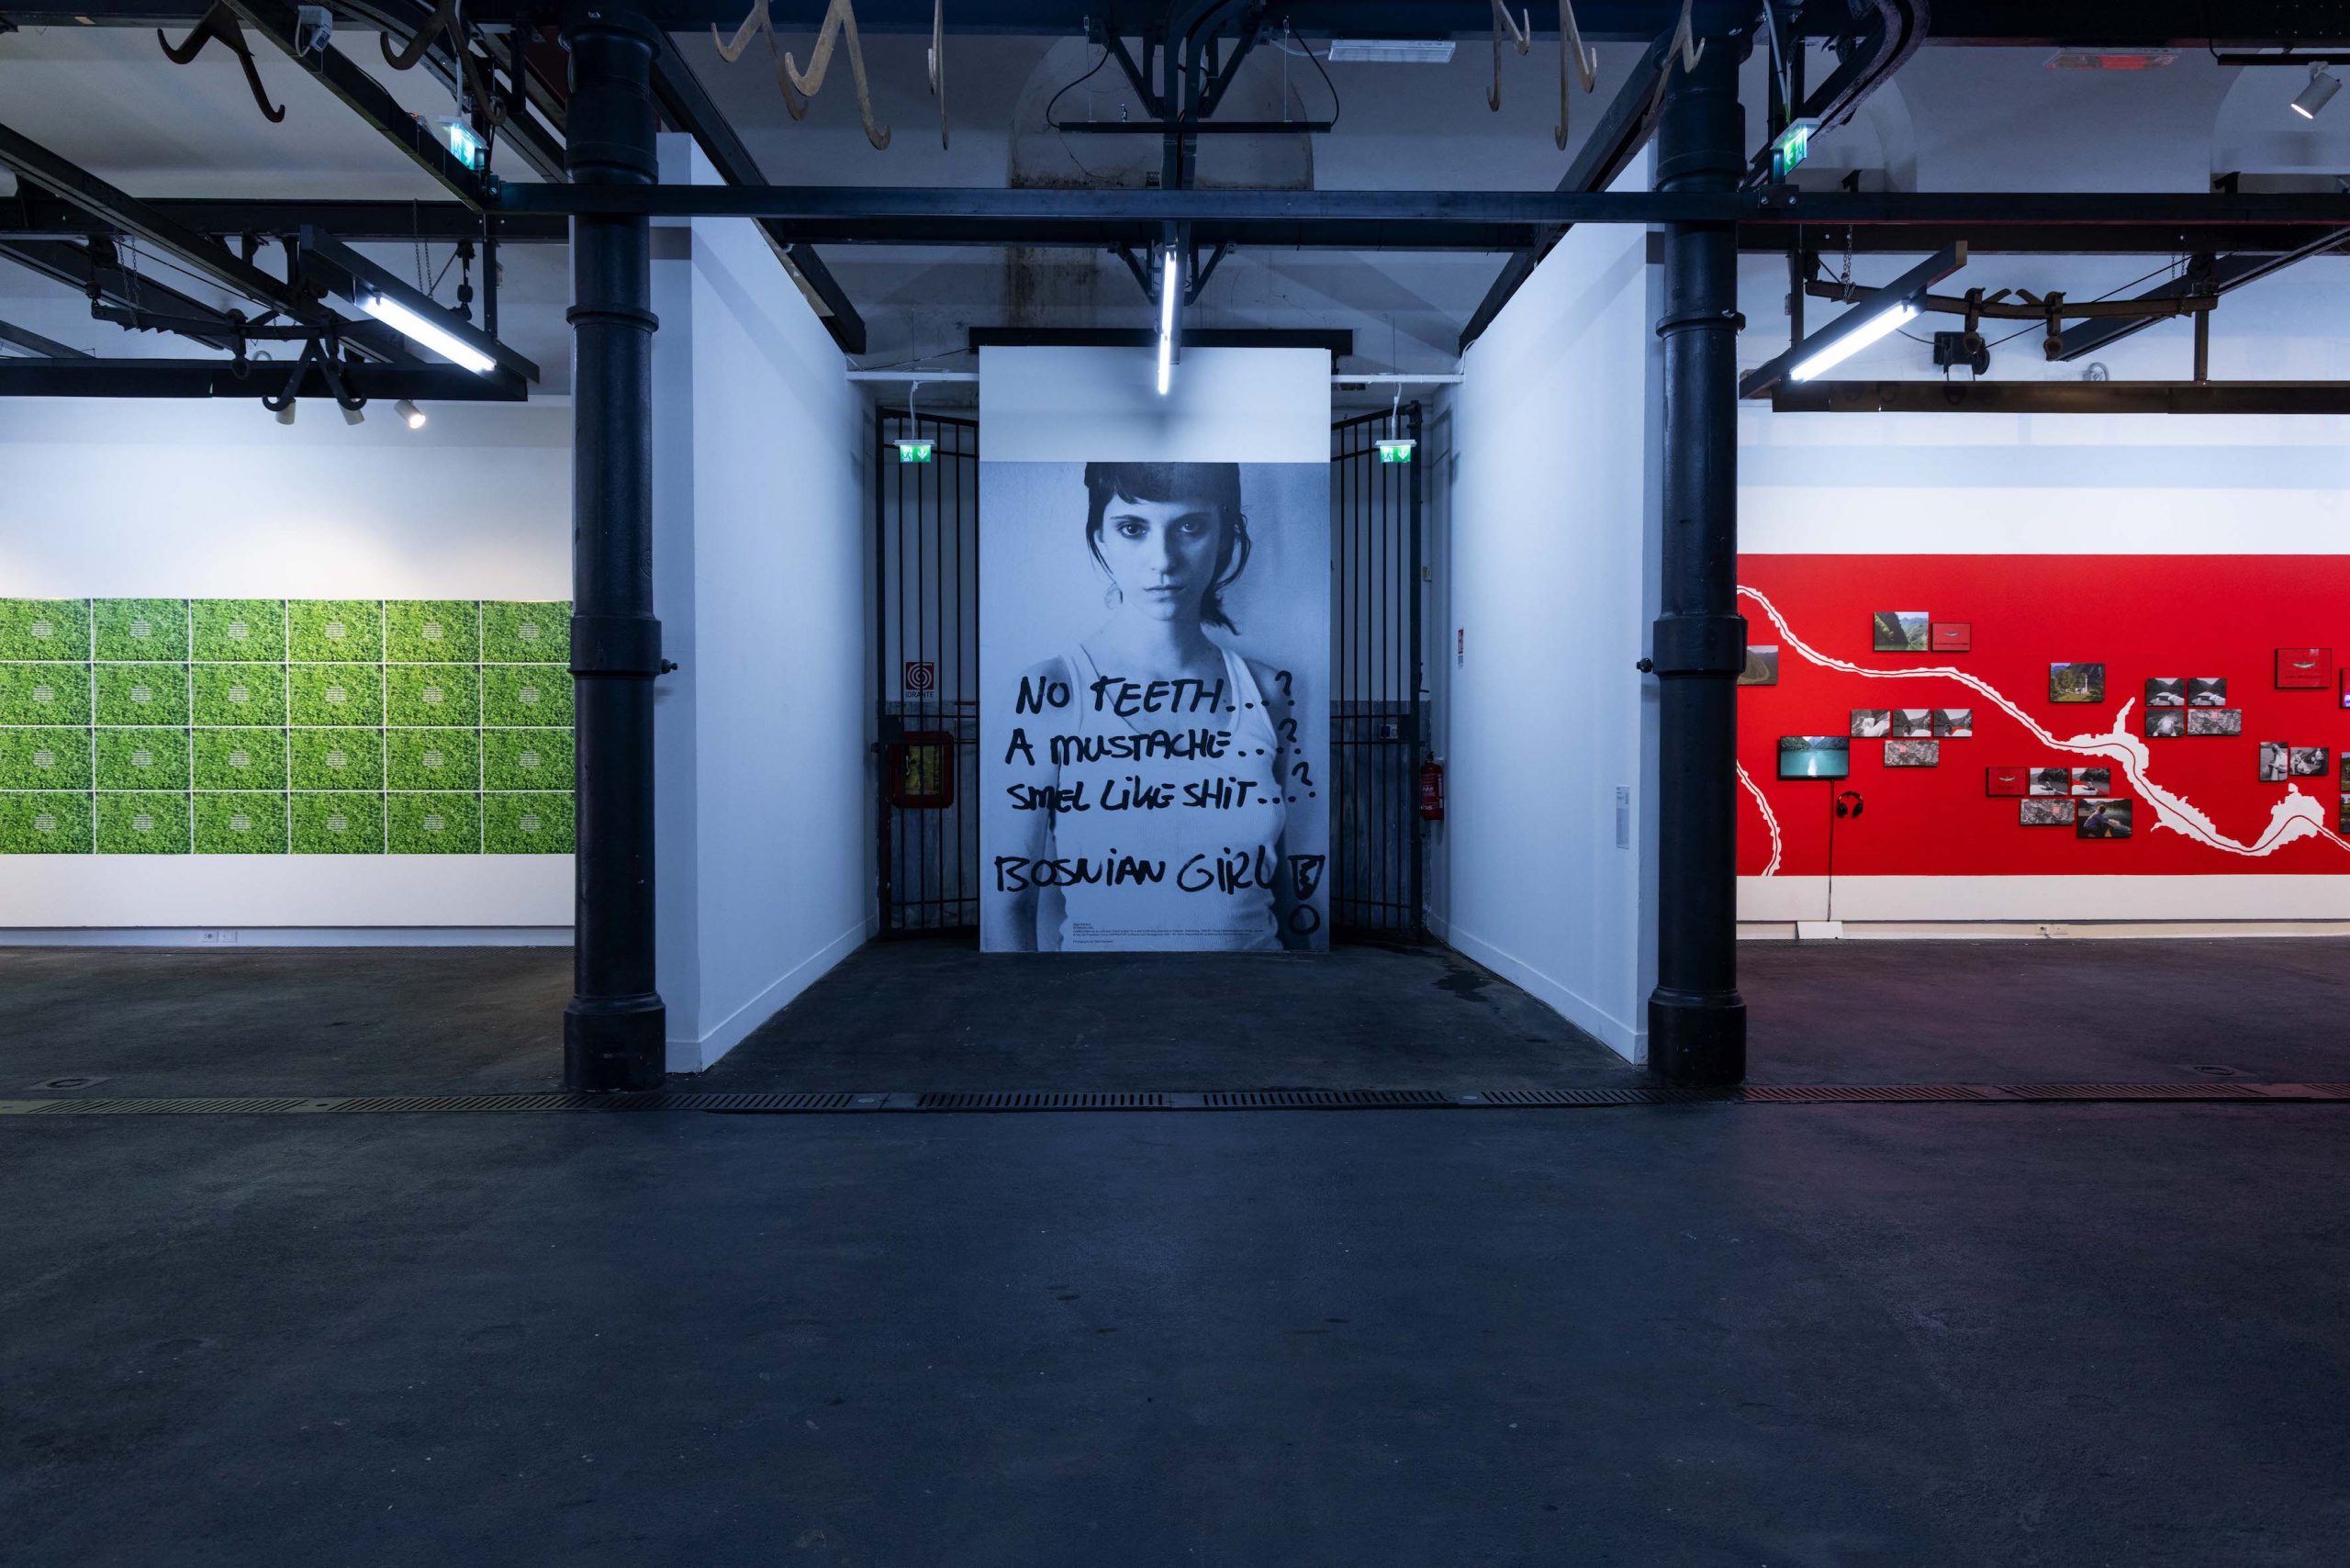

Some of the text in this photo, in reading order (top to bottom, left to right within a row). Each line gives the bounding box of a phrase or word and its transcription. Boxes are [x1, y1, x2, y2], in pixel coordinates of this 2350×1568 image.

[1015, 676, 1070, 714] NO
[1004, 728, 1035, 766] A
[1006, 780, 1091, 813] SMEL
[1100, 775, 1175, 811] LIKE
[994, 847, 1166, 891] BOSNIAN
